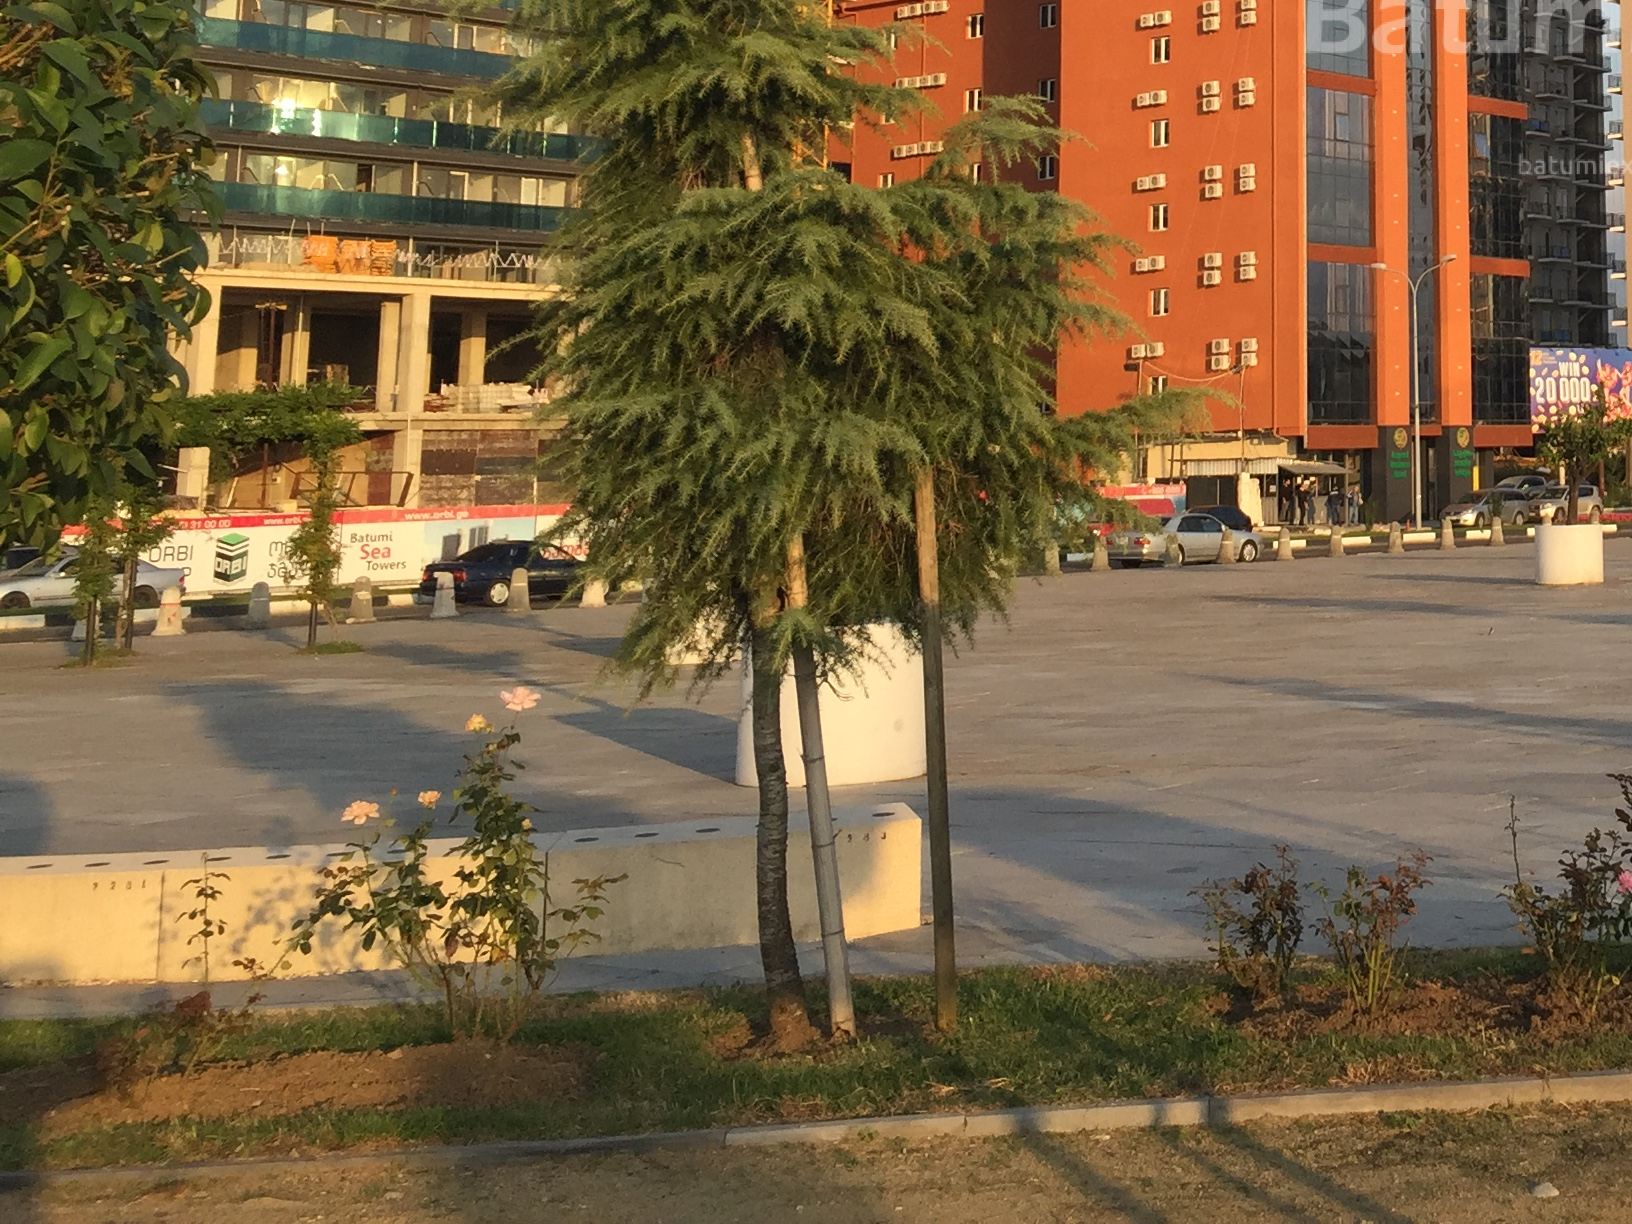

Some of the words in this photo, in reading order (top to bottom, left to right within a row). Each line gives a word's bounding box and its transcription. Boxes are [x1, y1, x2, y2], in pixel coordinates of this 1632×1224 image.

[1558, 361, 1580, 377] WIN
[1535, 376, 1557, 405] 20
[1559, 377, 1591, 404] 000
[404, 510, 469, 520] www.orbi.ge
[203, 520, 217, 528] 00
[218, 519, 231, 528] 00
[350, 531, 393, 543] Batumi
[149, 545, 194, 563] ORBI
[360, 543, 391, 560] Sea
[214, 556, 248, 576] ORBI
[365, 560, 407, 571] Towers
